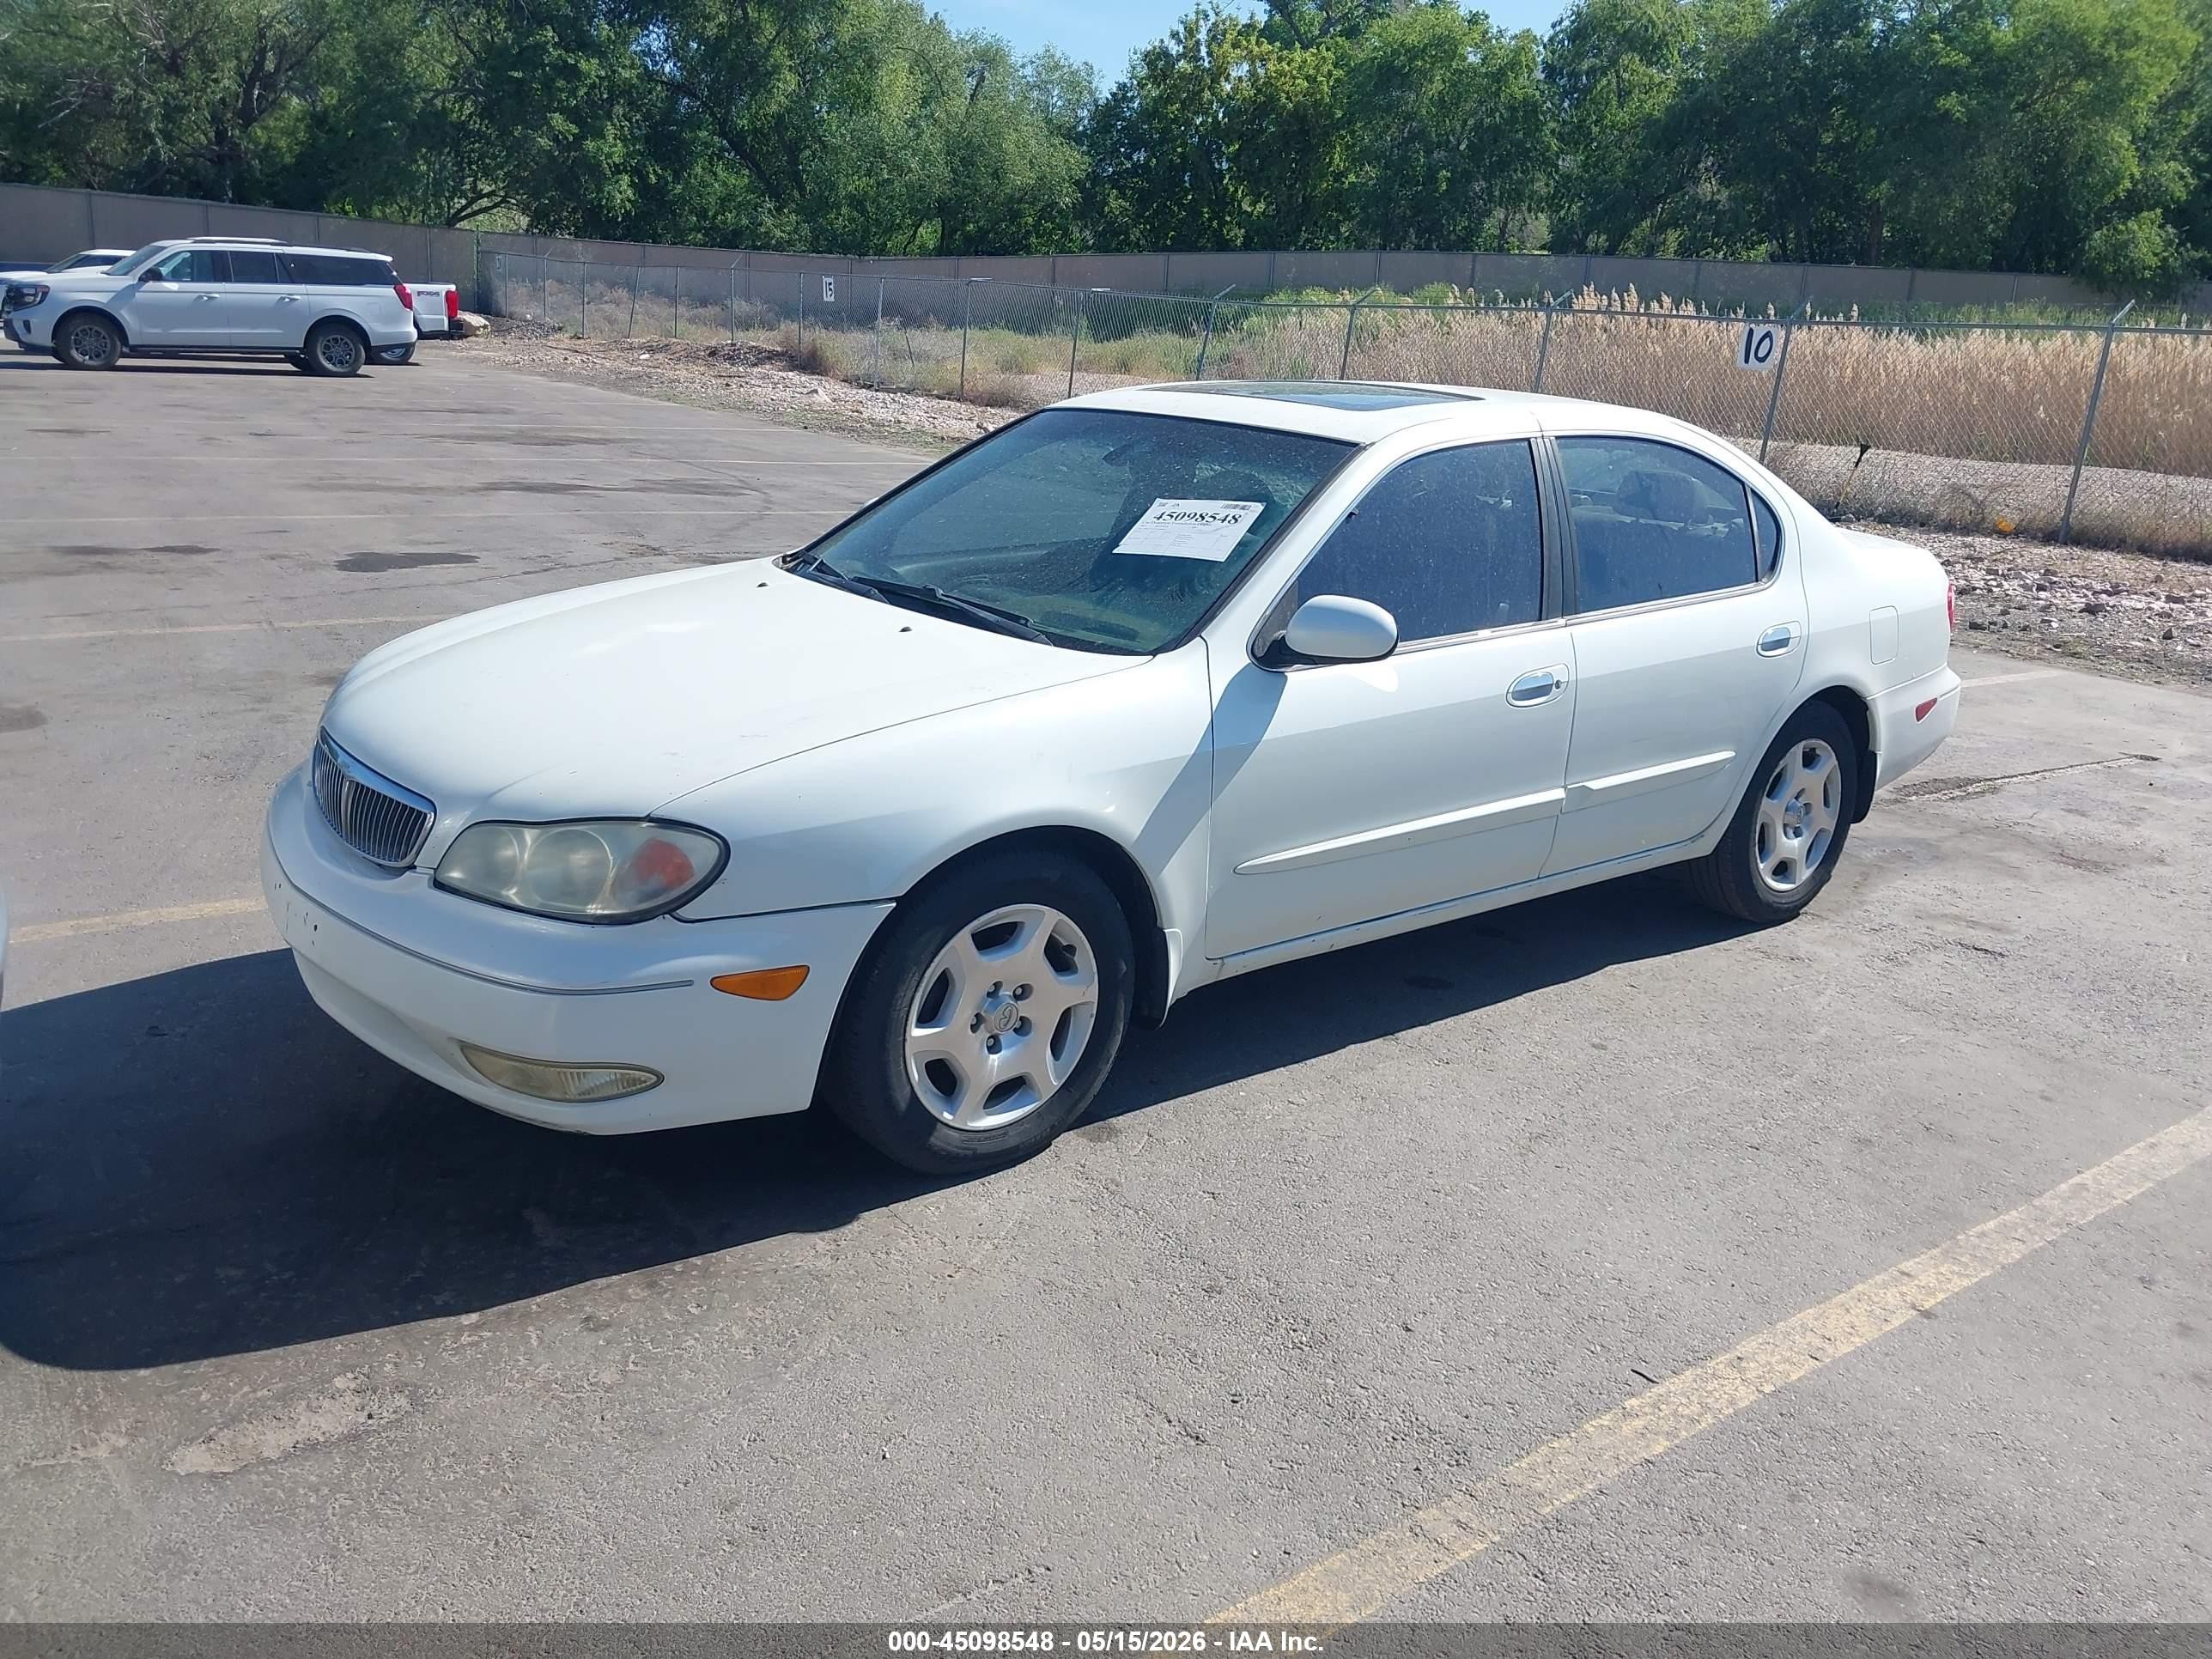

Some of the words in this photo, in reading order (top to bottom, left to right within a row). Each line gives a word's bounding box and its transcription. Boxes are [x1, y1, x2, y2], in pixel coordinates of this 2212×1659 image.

[825, 281, 834, 298] 15
[1744, 327, 1774, 364] 10
[1153, 511, 1243, 525] 45098548
